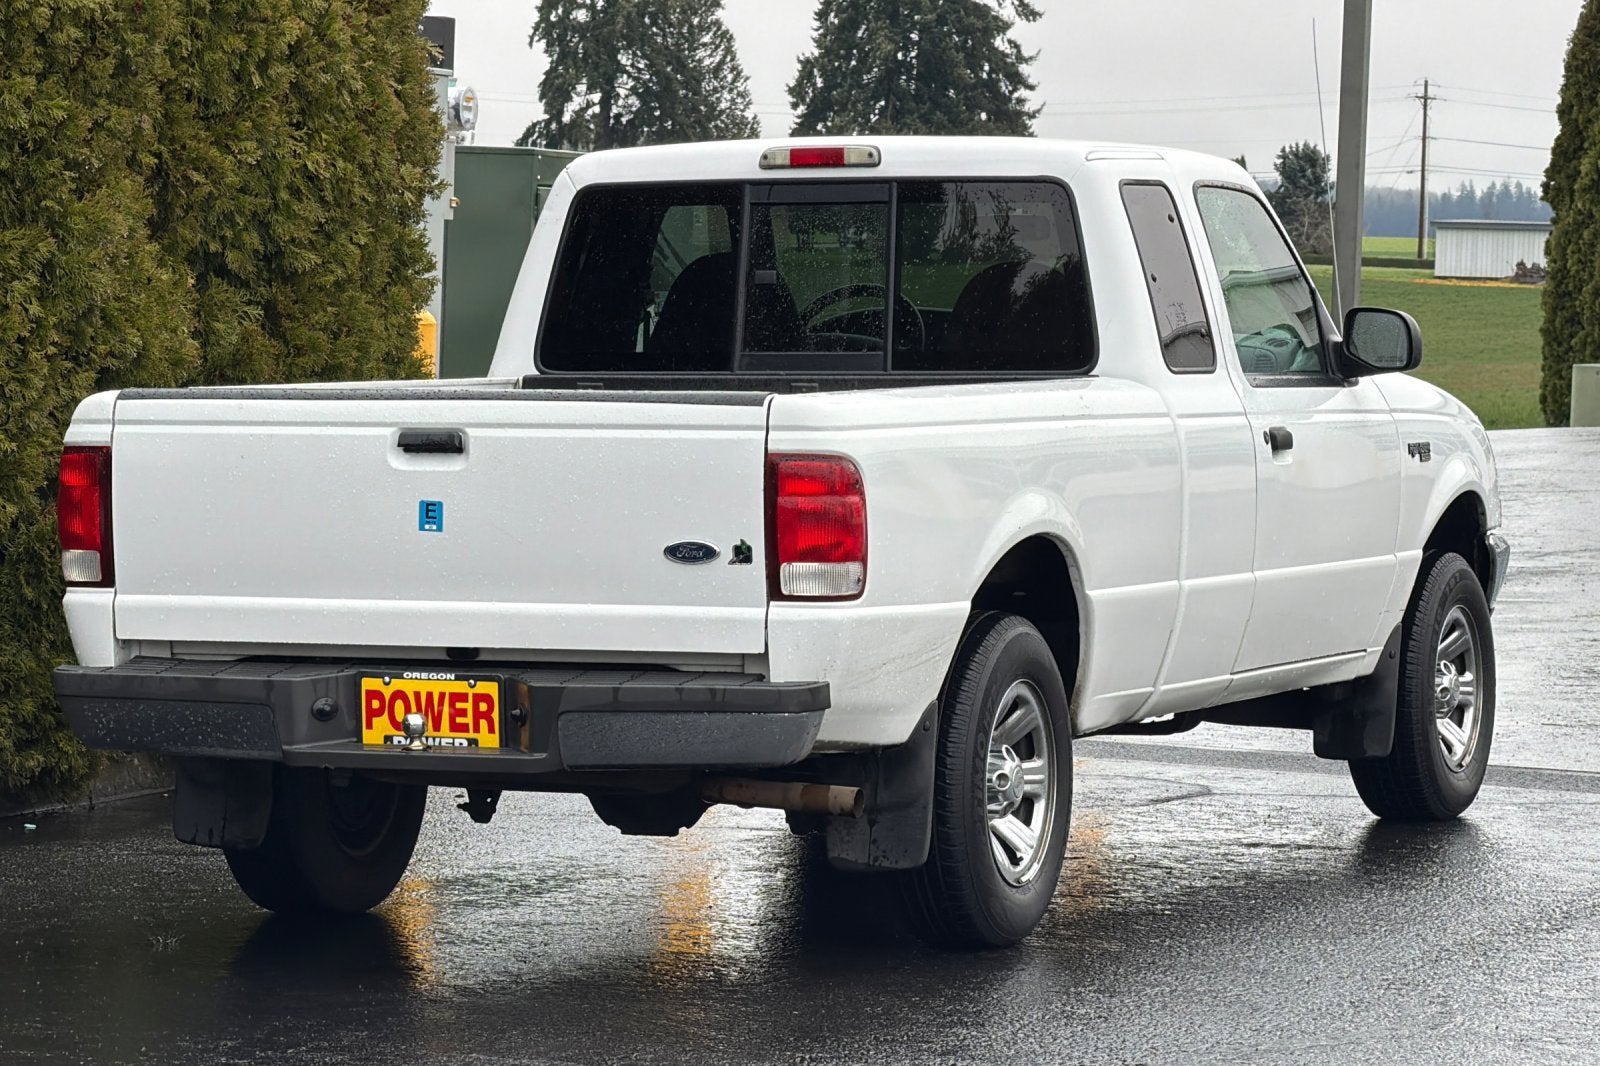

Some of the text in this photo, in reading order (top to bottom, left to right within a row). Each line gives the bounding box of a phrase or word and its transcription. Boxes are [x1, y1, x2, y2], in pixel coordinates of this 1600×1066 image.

[426, 502, 438, 520] E
[676, 543, 706, 558] Ford
[403, 672, 455, 681] OREGON
[364, 688, 497, 735] POWER
